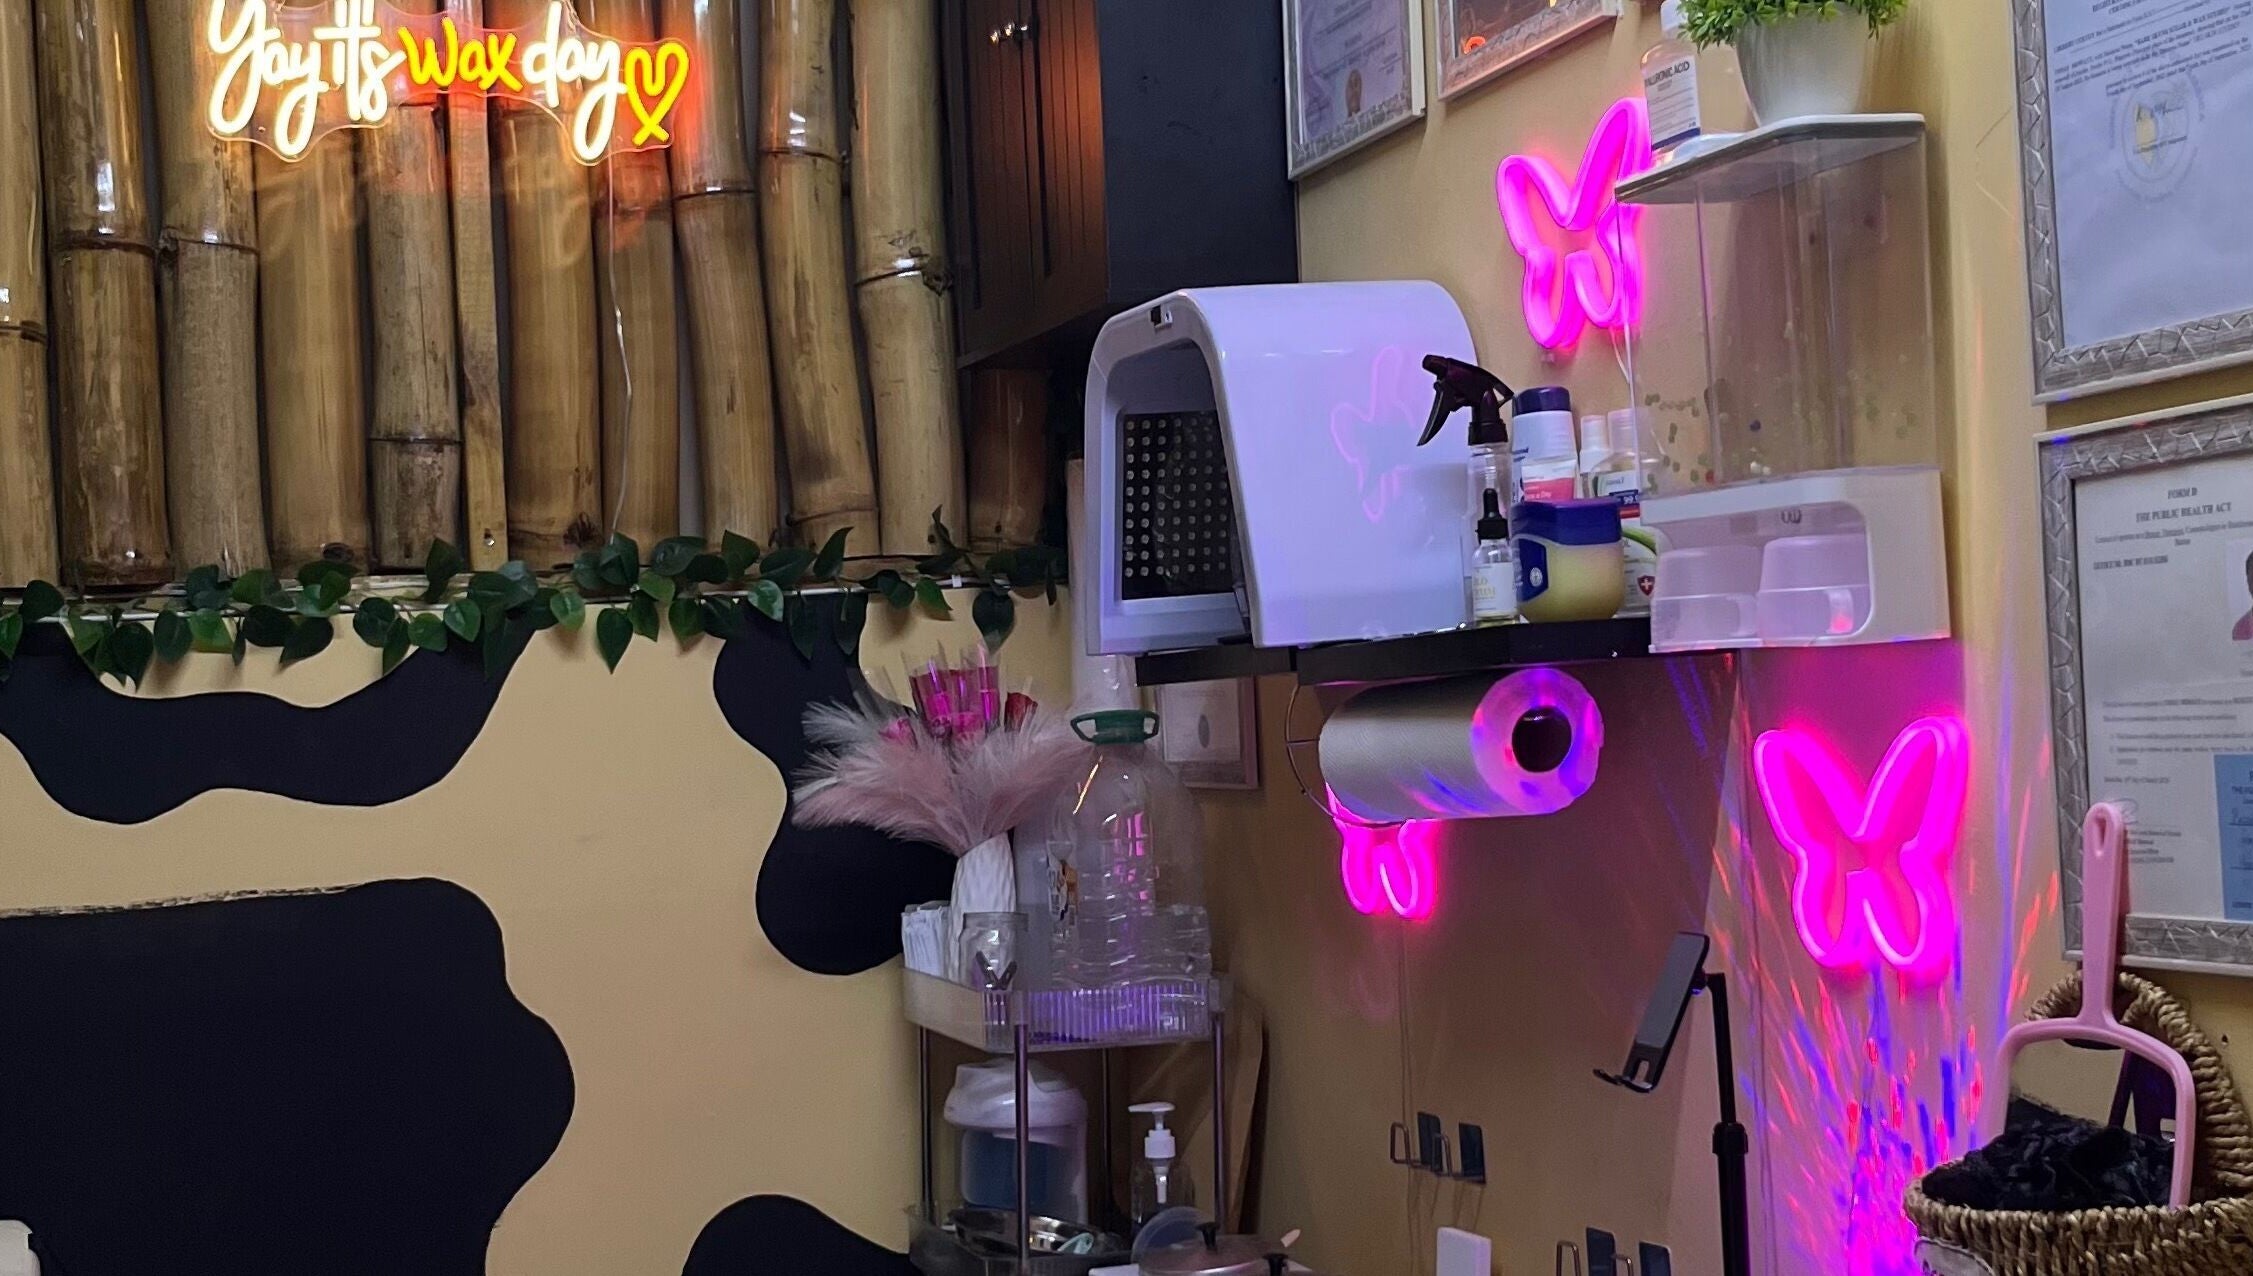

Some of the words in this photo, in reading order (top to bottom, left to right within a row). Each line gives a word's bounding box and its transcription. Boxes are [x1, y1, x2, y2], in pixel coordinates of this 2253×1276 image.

[1674, 60, 1690, 75] ACID
[521, 0, 627, 166] day
[2167, 488, 2190, 499] FORM
[2136, 512, 2151, 523] THE
[2152, 508, 2179, 521] PUBLIC
[2180, 504, 2214, 518] HEALTH
[2215, 501, 2233, 513] ACT
